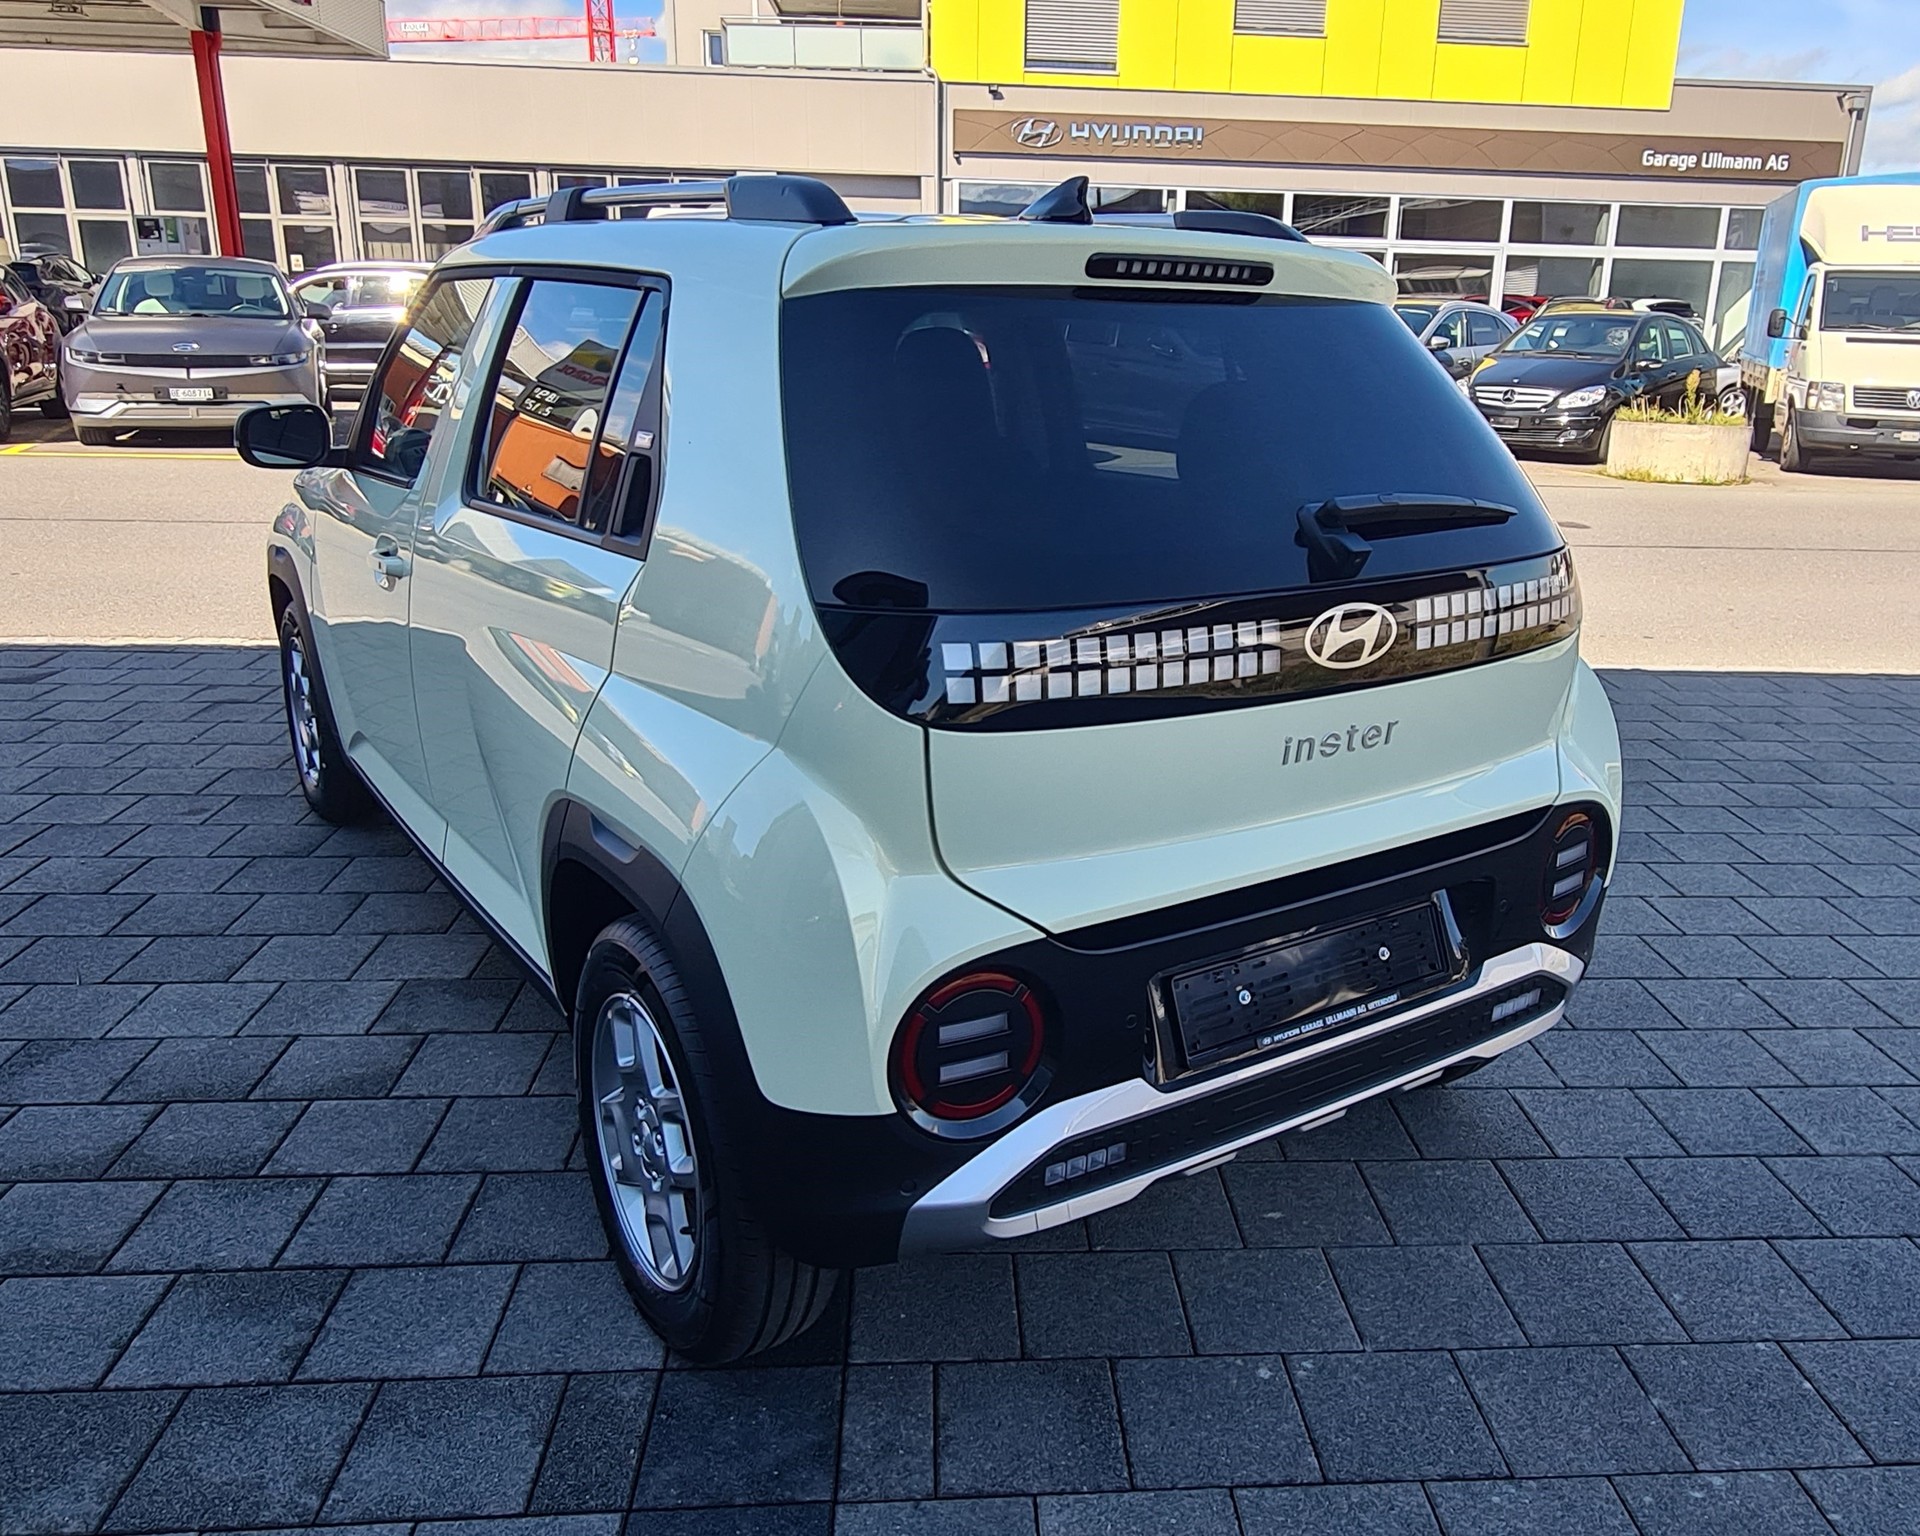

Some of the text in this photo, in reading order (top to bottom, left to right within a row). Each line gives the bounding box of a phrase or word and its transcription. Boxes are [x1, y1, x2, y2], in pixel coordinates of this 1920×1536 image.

[1070, 121, 1204, 149] HYUNDAI
[1642, 150, 1790, 171] Garage Ullmann AG
[1281, 719, 1400, 766] inster
[1325, 1007, 1357, 1024] ULLMANN
[1357, 1004, 1367, 1014] AG
